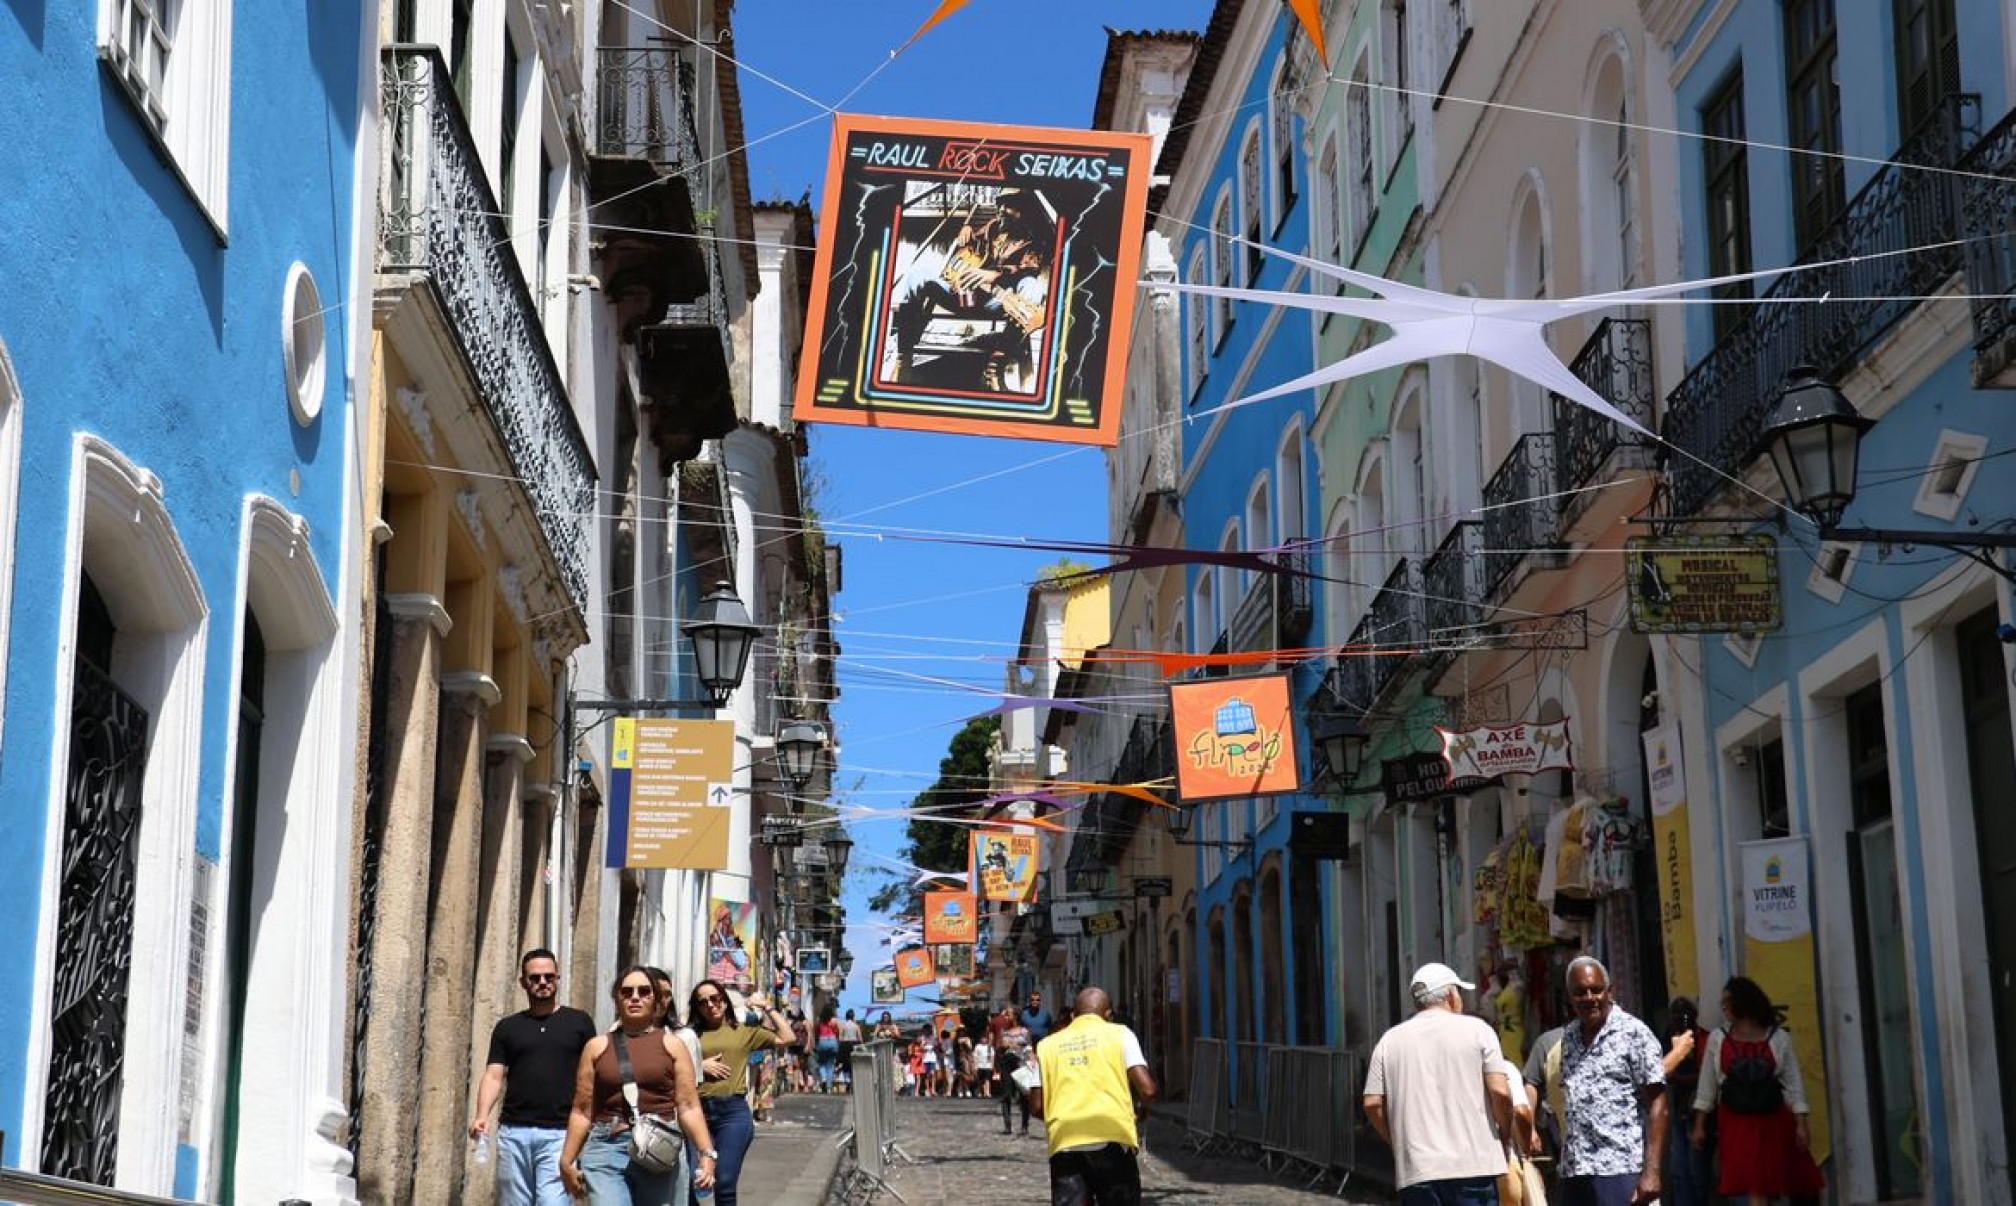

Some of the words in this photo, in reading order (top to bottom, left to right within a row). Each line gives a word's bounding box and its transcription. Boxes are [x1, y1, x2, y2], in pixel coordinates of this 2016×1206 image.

[867, 142, 930, 168] RAUL
[938, 148, 1010, 172] ROCK
[1014, 153, 1106, 181] SEIXAS
[1681, 559, 1738, 572] MUSICAL
[1486, 726, 1526, 744] AXÉ
[1477, 746, 1536, 762] BAMBA
[1667, 830, 1683, 921] Bamba
[1753, 885, 1797, 902] VITRINE
